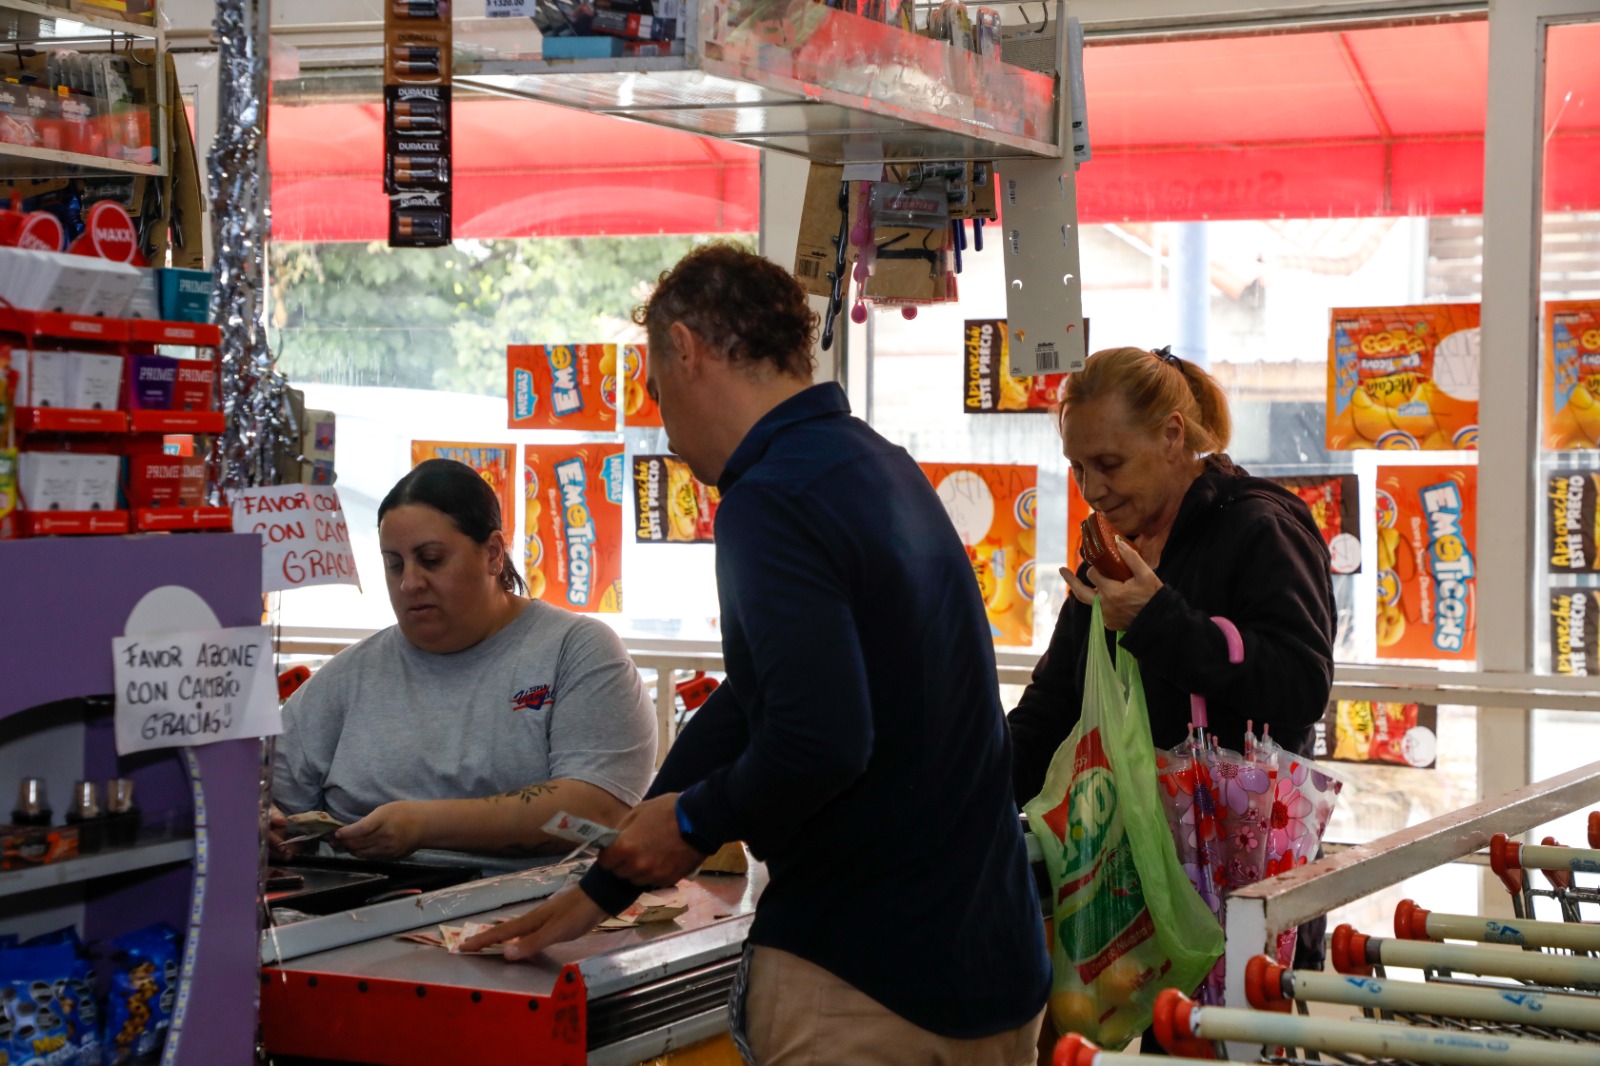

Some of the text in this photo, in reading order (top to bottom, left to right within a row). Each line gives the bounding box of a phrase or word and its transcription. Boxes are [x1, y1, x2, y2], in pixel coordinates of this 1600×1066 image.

[398, 88, 439, 96] DURACELL
[399, 142, 440, 151] DURACELL
[96, 227, 131, 243] MAXX
[139, 366, 174, 382] PRIME
[178, 367, 212, 383] PRIME
[965, 326, 982, 407] Aprovechá
[979, 324, 993, 409] ESTE PRECIO
[517, 373, 529, 416] NUEVAS
[146, 464, 179, 478] PRIME
[242, 492, 310, 515] FAVOR
[634, 461, 650, 539] Aprovechá
[648, 460, 663, 540] ESTE PRECIO
[252, 521, 305, 548] CON
[1547, 476, 1569, 567] Aprovechá
[1567, 474, 1585, 569] ESTE PRECIO
[1570, 592, 1587, 648] PRECIO
[122, 642, 259, 669] FAVOR ABONE
[126, 680, 169, 705] CON
[529, 683, 547, 693] SUPER
